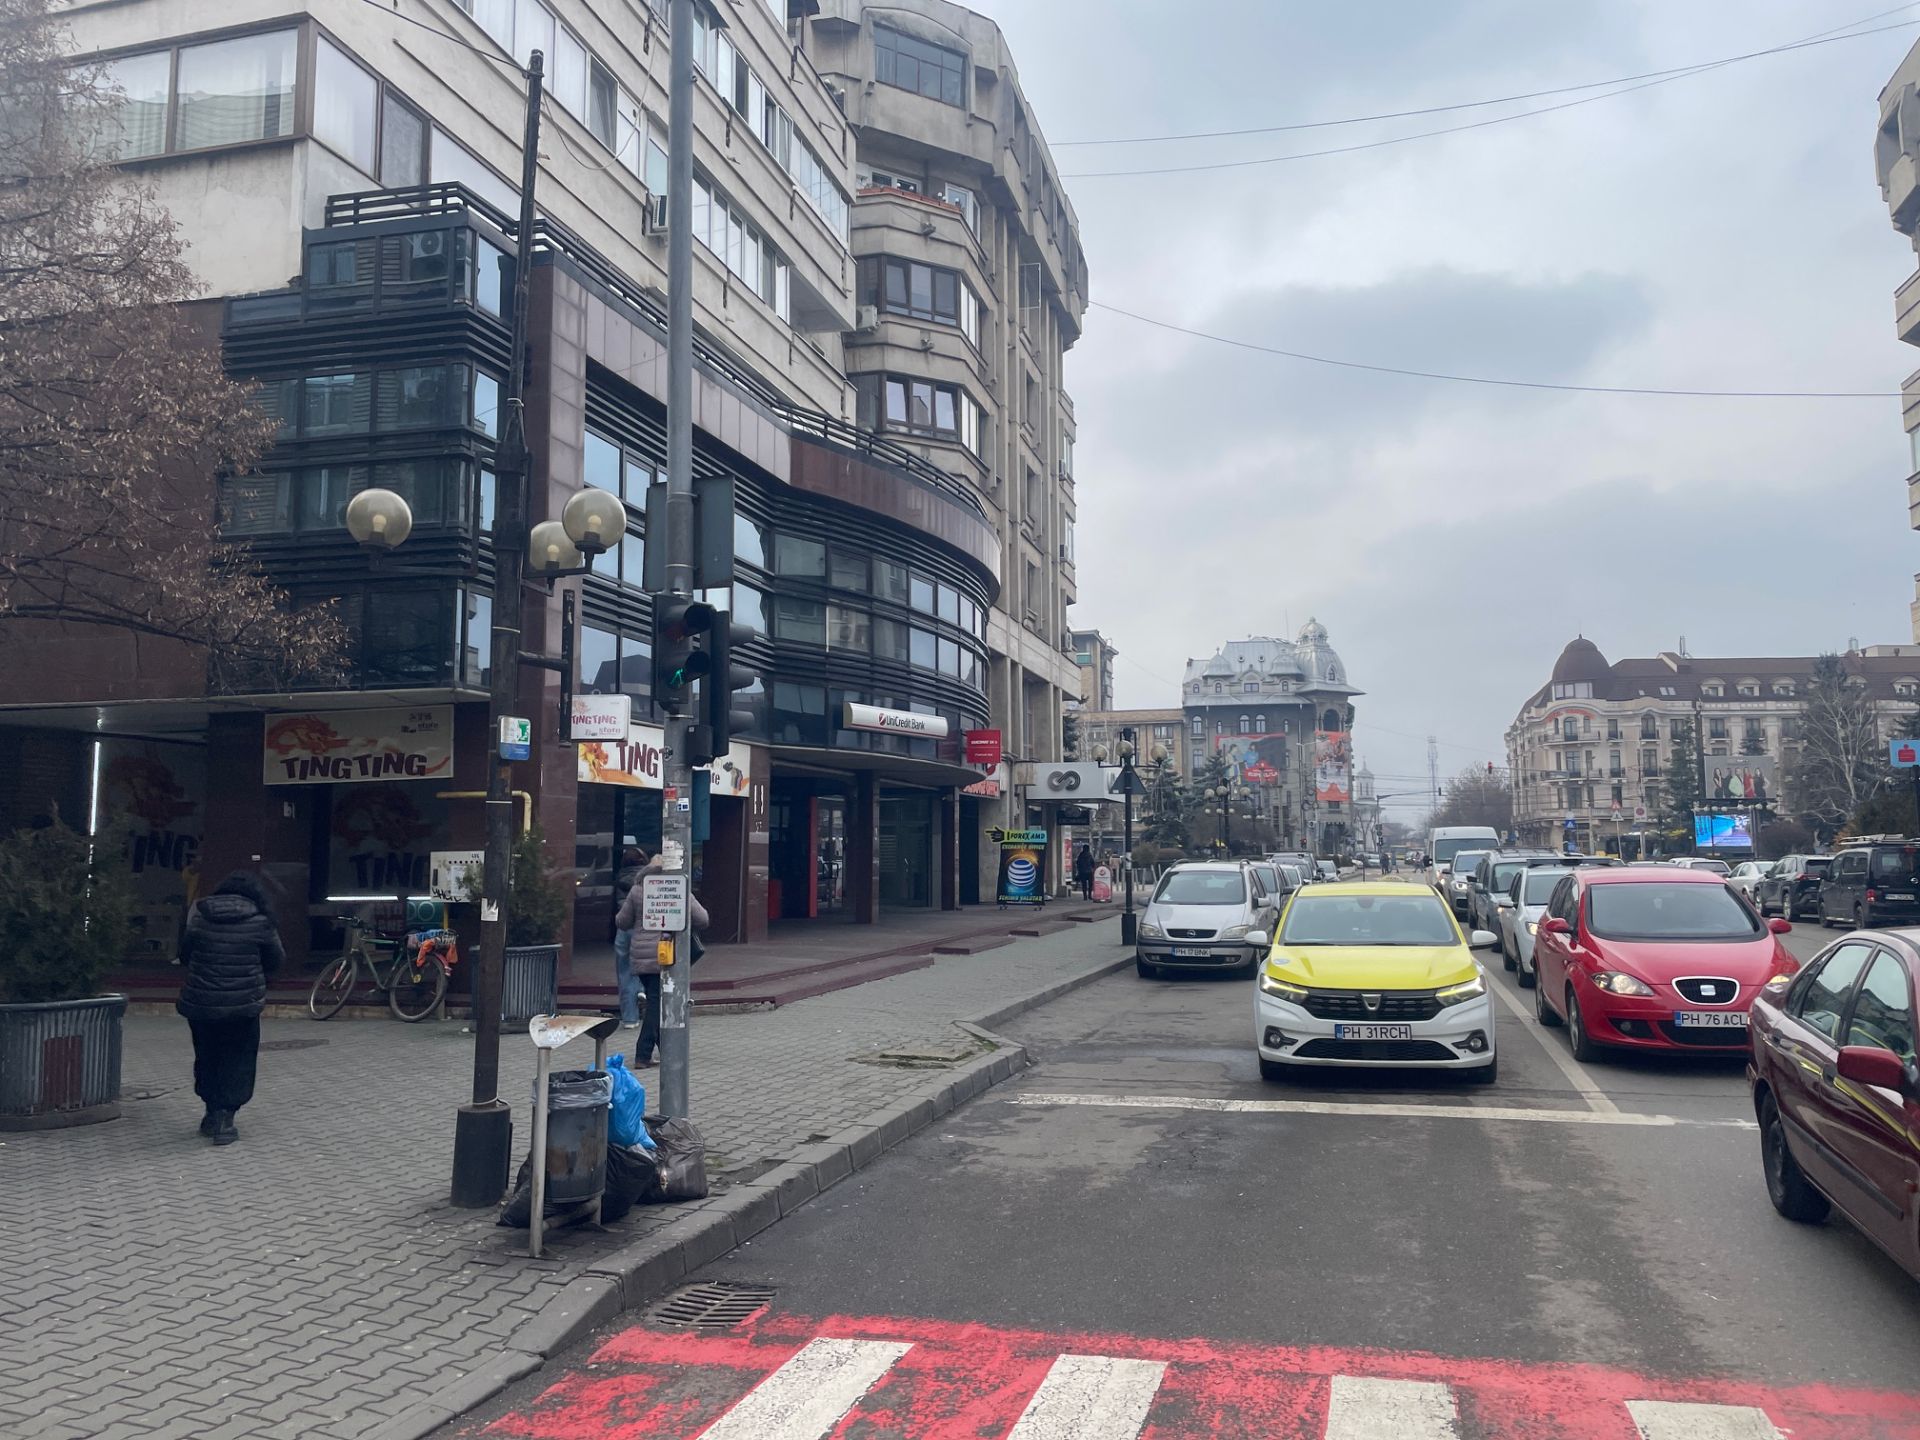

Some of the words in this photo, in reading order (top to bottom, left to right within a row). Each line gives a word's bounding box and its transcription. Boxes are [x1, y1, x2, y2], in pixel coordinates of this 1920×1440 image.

[886, 714, 911, 729] UniCredit
[912, 718, 925, 730] Bank
[1010, 831, 1031, 841] FOREX
[1031, 832, 1046, 840] AMD
[1681, 1013, 1700, 1025] PH
[1705, 1014, 1720, 1026] 76
[1723, 1014, 1746, 1026] ACL
[1343, 1026, 1361, 1039] PH
